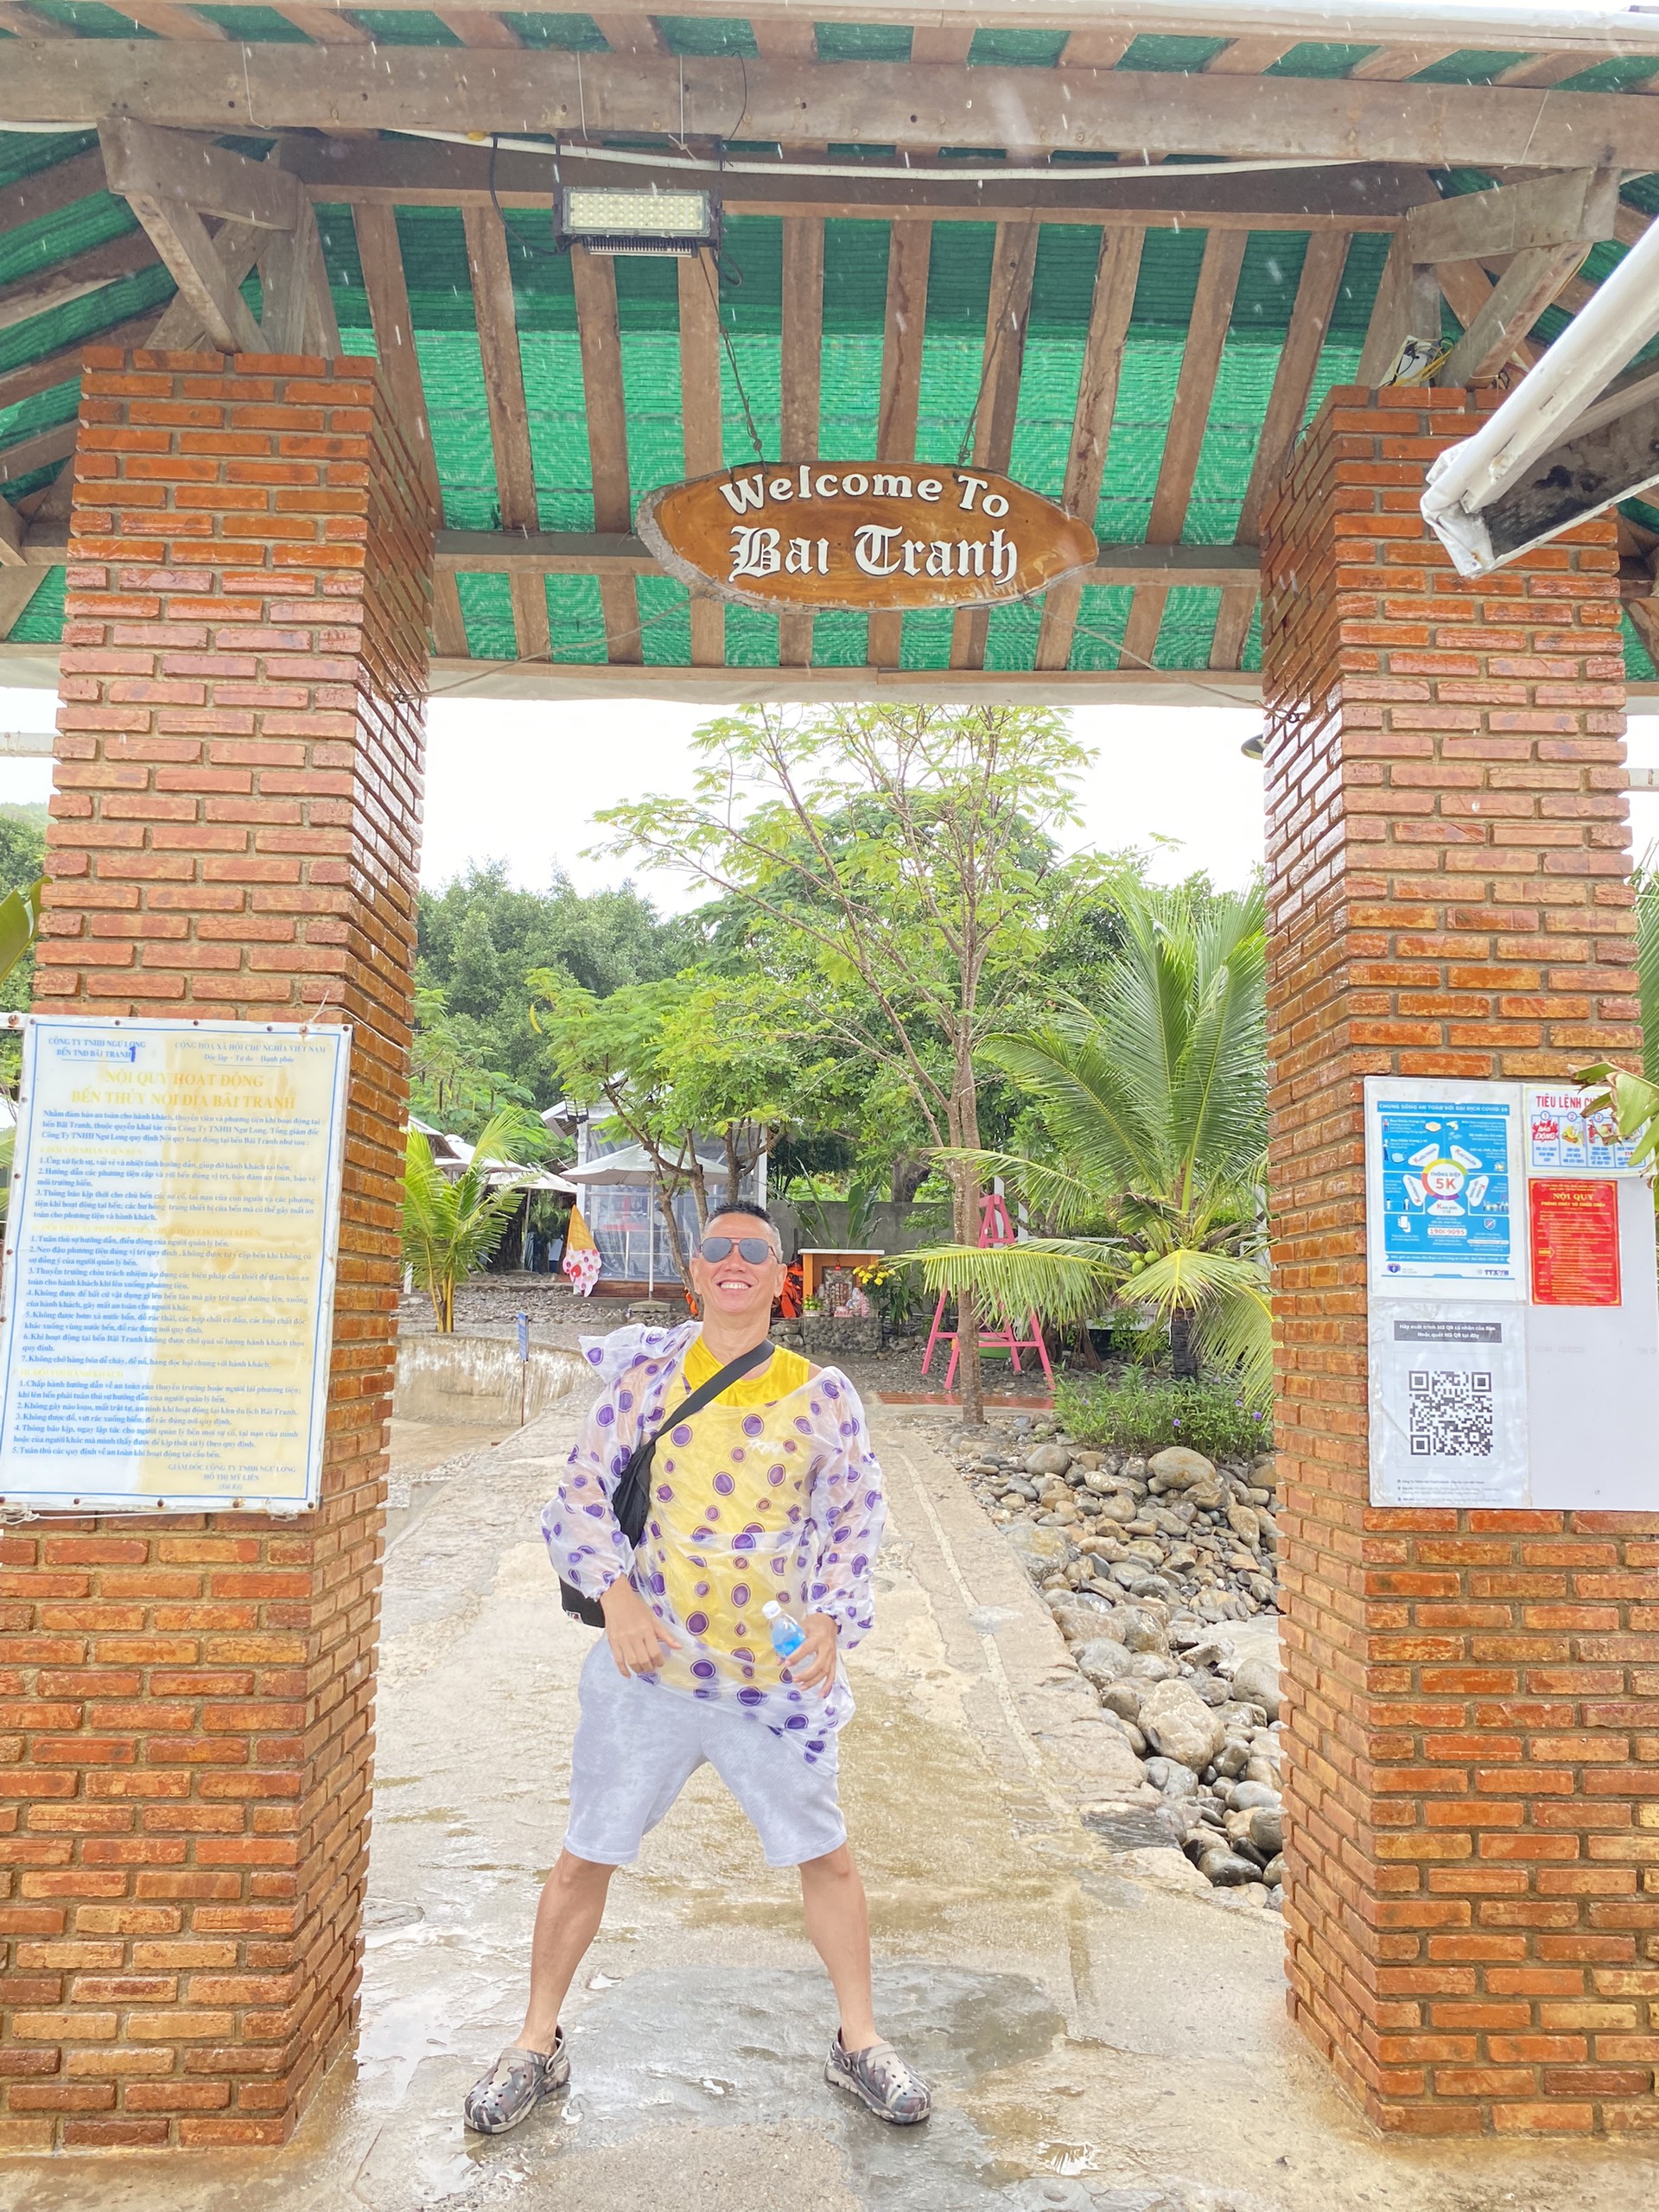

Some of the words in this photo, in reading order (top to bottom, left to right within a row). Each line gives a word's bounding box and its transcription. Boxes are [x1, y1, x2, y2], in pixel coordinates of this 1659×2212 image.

[719, 464, 944, 515] Welcome
[957, 474, 1009, 518] To
[728, 525, 830, 582] Bai
[854, 524, 1018, 585] Tranh
[48, 1036, 70, 1046] CÔNG
[175, 1039, 196, 1050] CỘNG
[228, 1041, 243, 1052] HỘI
[289, 1044, 306, 1054] VIỆT
[55, 1046, 72, 1056] BẾN
[89, 1048, 103, 1057] BÃI
[104, 1067, 133, 1085] NỘI
[136, 1071, 168, 1086] QUY
[174, 1072, 217, 1088] HOẠT
[219, 1071, 264, 1090] ĐỘNG
[213, 1091, 239, 1107] BÃI
[243, 1096, 295, 1109] TRANH
[1536, 1093, 1555, 1108] TIÊU
[1559, 1094, 1581, 1110] LỆNH
[1436, 1178, 1456, 1189] 5K
[1553, 1192, 1571, 1201] NỘI
